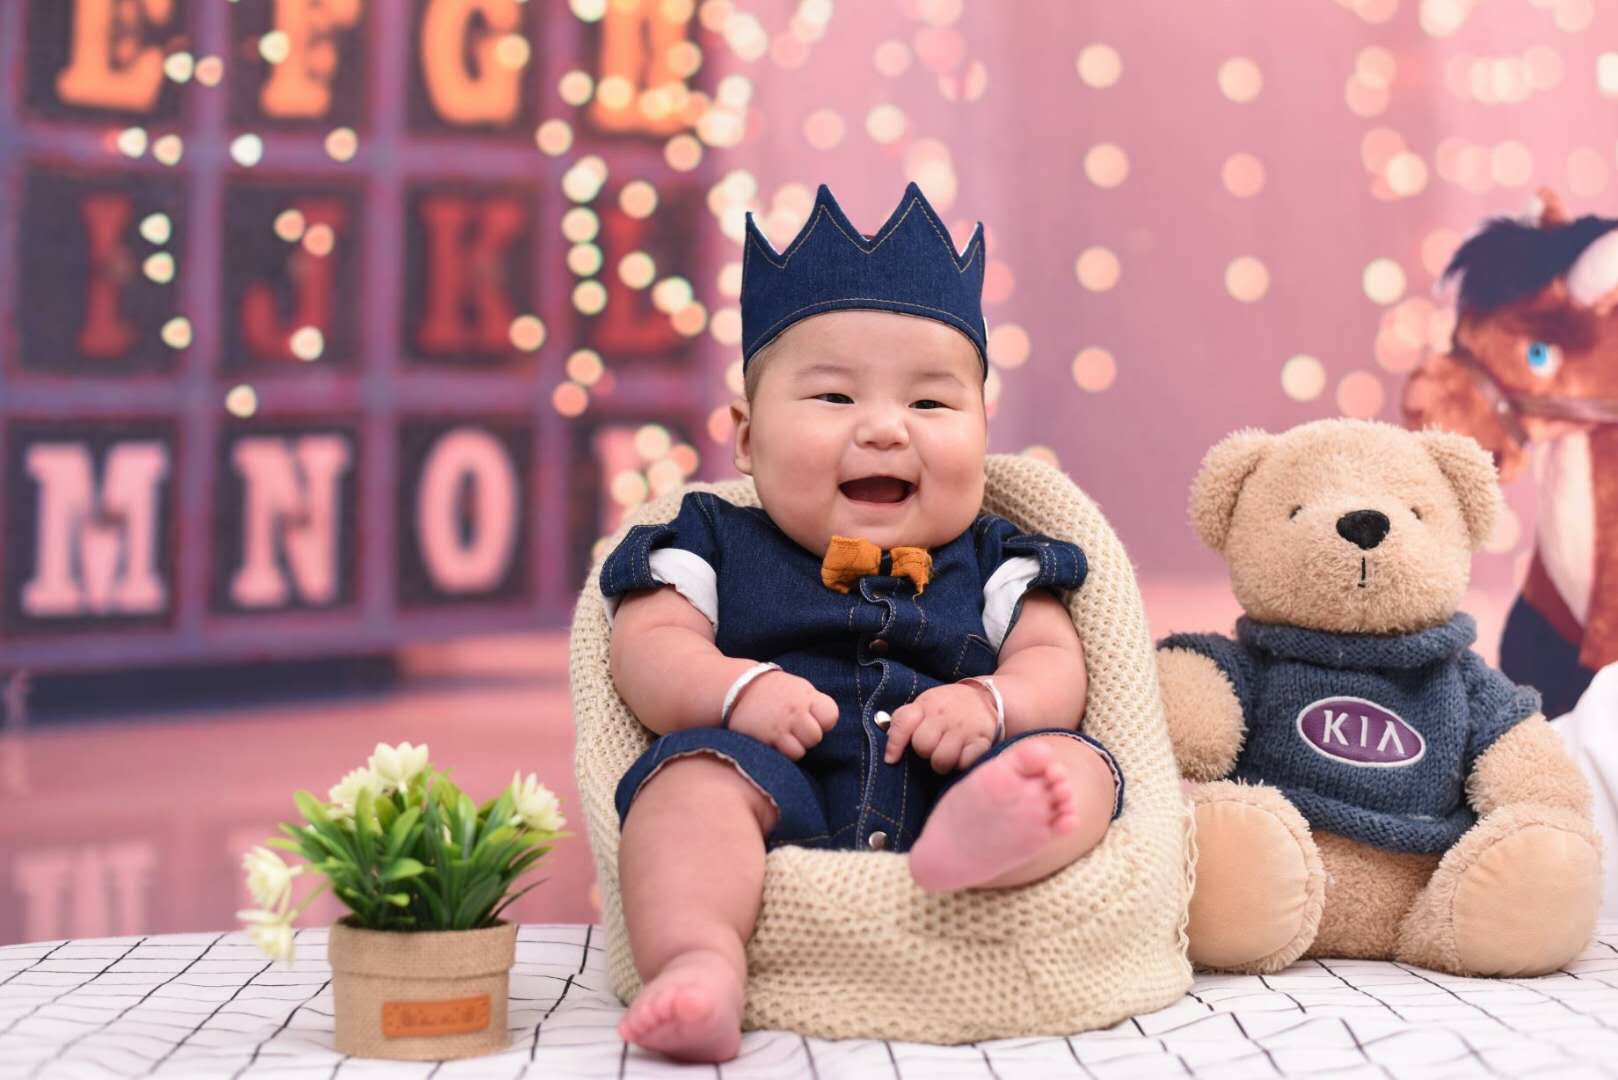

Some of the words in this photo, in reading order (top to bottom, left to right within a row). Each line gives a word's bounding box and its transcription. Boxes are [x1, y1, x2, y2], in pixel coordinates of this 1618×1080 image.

[421, 0, 523, 122] G
[79, 195, 135, 357] I
[241, 199, 345, 360] J
[417, 197, 526, 354] K
[24, 441, 168, 615] M
[230, 434, 348, 606] N
[415, 430, 518, 593] O
[1322, 709, 1408, 757] KIA
